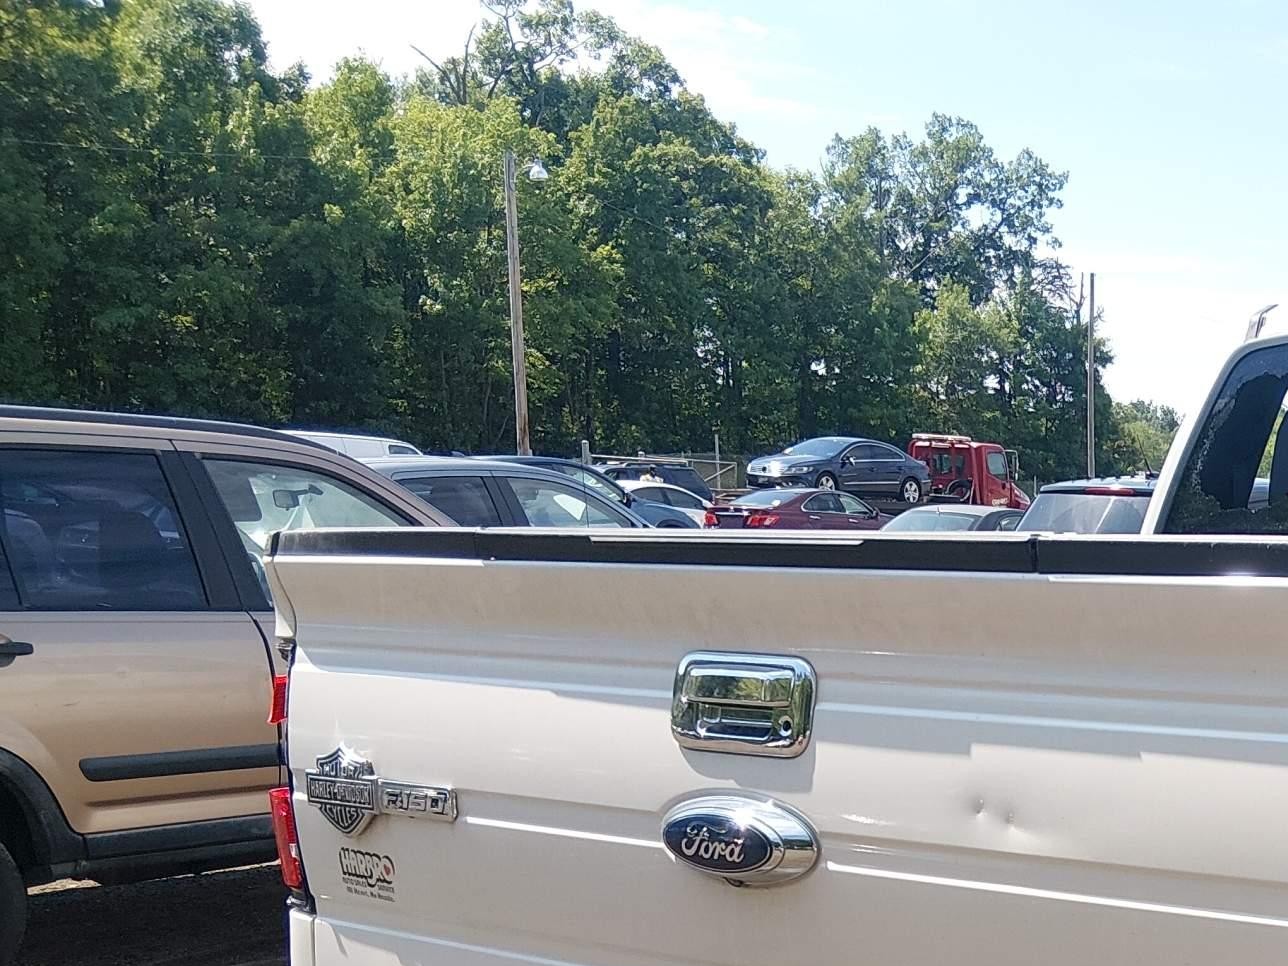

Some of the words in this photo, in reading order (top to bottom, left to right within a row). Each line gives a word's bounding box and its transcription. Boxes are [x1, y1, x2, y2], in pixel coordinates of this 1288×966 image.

[309, 779, 371, 805] HARLEY-DAVIDSON
[325, 803, 358, 827] CYCLES
[681, 823, 744, 863] Ford
